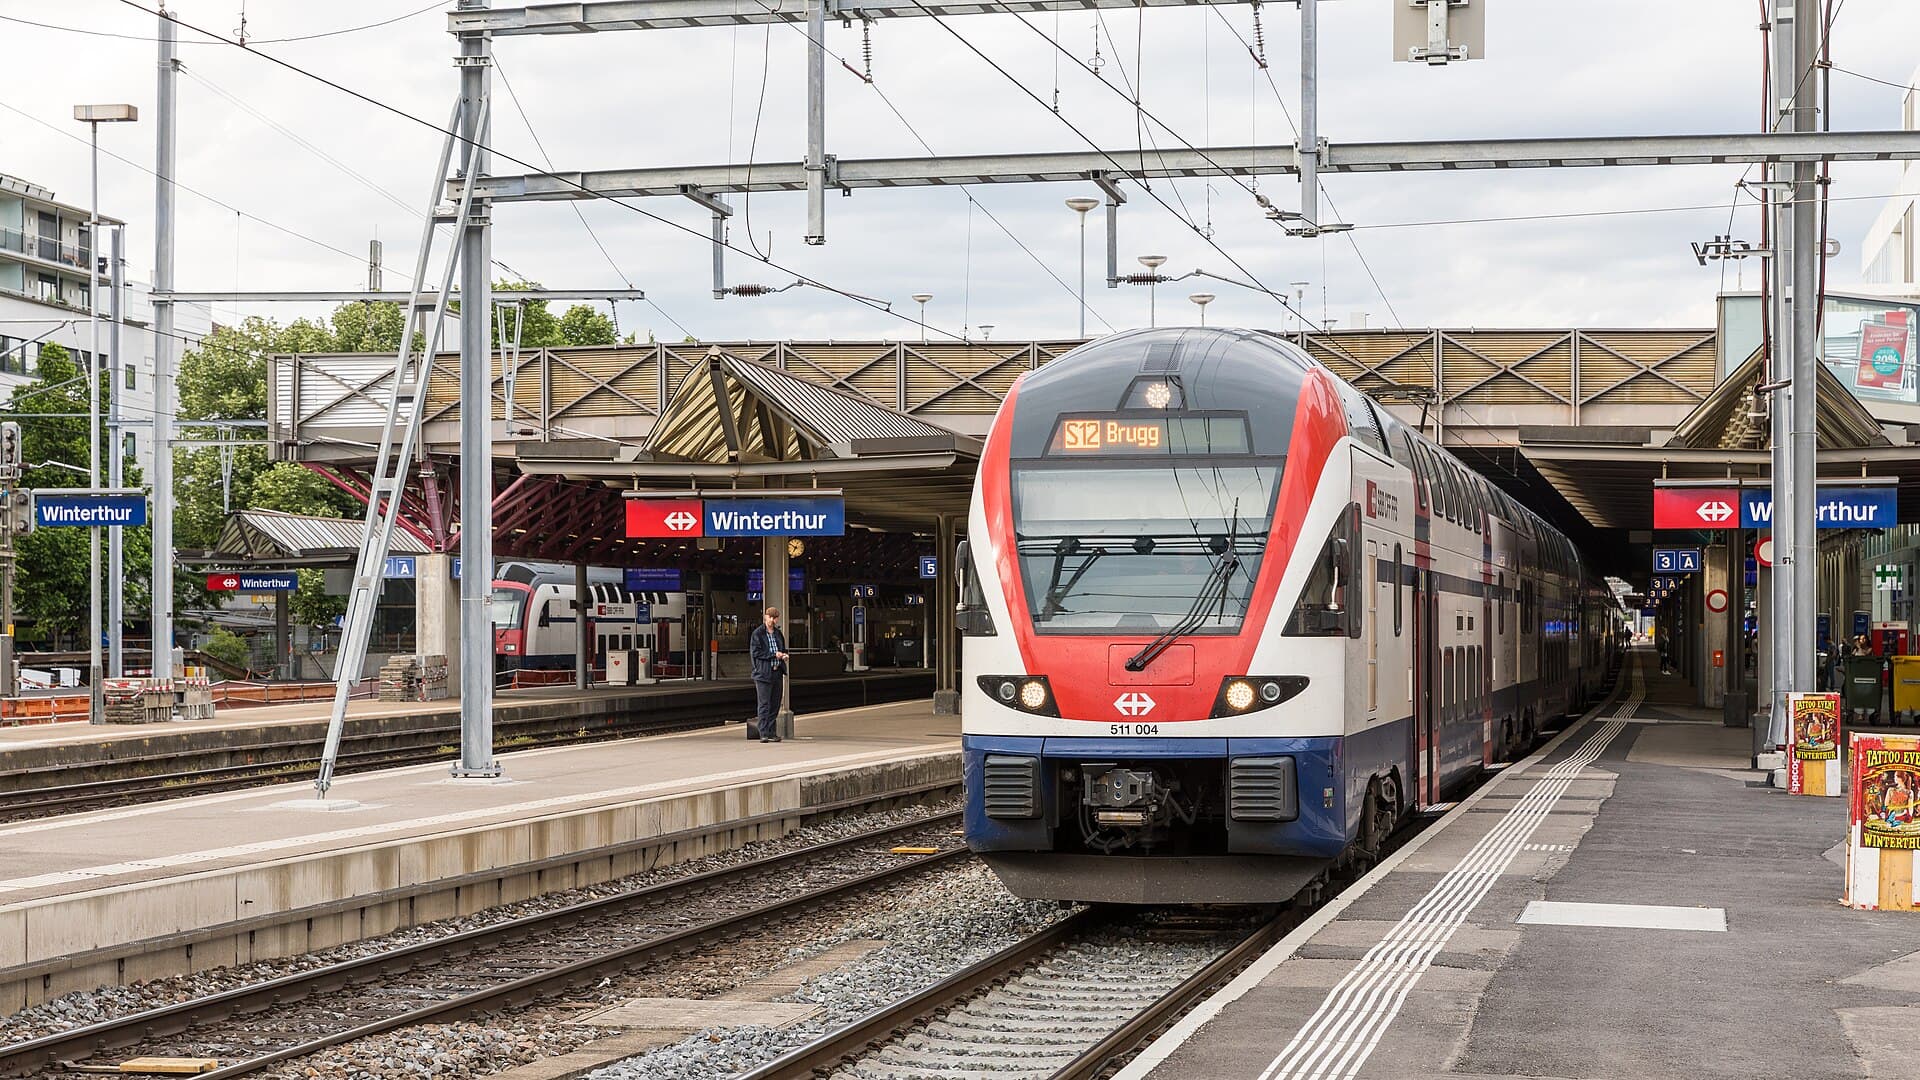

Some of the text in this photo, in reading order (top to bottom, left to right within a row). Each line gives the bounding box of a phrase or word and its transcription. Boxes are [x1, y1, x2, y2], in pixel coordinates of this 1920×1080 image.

[1066, 422, 1159, 447] S12 Brugg
[42, 505, 132, 522] Winterthur
[1749, 501, 1878, 522] Wrthur
[711, 511, 827, 530] Winterthur
[1661, 556, 1694, 569] 3 A
[400, 563, 410, 575] A
[927, 563, 935, 575] 5
[241, 578, 291, 589] Winterthur
[1795, 700, 1836, 711] TATTOO EVENT
[1110, 724, 1159, 735] 511 004
[1795, 751, 1836, 760] WINTERTHUR
[1866, 749, 1901, 767] TATTOO
